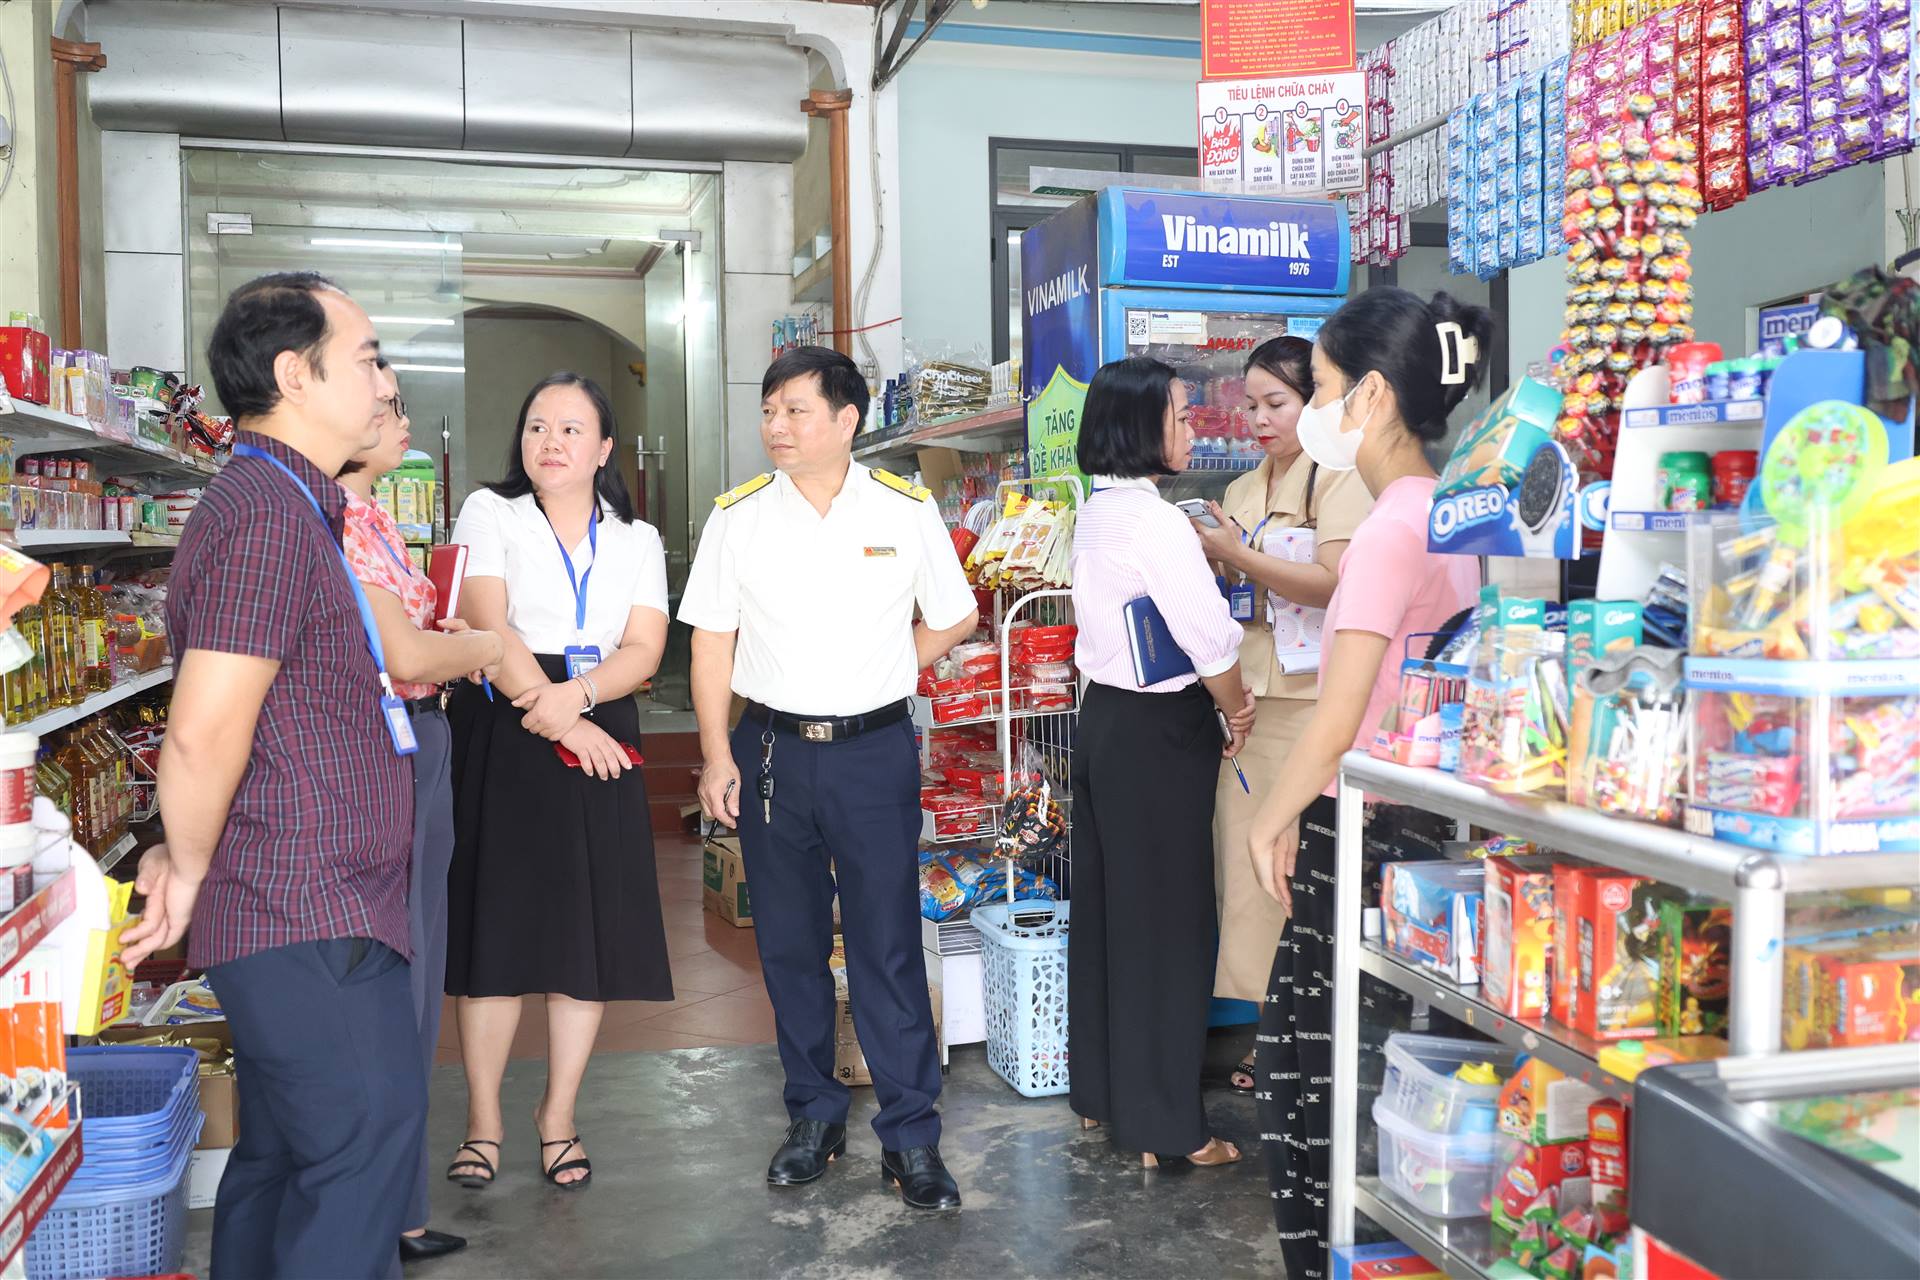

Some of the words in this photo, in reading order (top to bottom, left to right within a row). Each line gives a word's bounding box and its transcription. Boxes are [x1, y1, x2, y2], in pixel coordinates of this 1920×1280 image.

[1227, 85, 1248, 101] TIÊU
[1250, 84, 1275, 102] LỆNH
[1278, 82, 1305, 97] CHỮA
[1307, 79, 1335, 95] CHÁY
[1258, 108, 1265, 117] 2
[1299, 105, 1305, 115] 3
[1339, 102, 1345, 111] 4
[1219, 110, 1225, 119] 1
[1161, 214, 1311, 259] Vinamilk
[1162, 255, 1179, 268] EST
[1289, 262, 1310, 276] 1976
[1027, 263, 1088, 317] VINAMILK
[1045, 408, 1075, 436] TĂNG
[1668, 407, 1717, 423] mentos
[1033, 443, 1047, 474] ĐỀ
[1433, 491, 1503, 536] OREO
[1692, 667, 1735, 682] mentos
